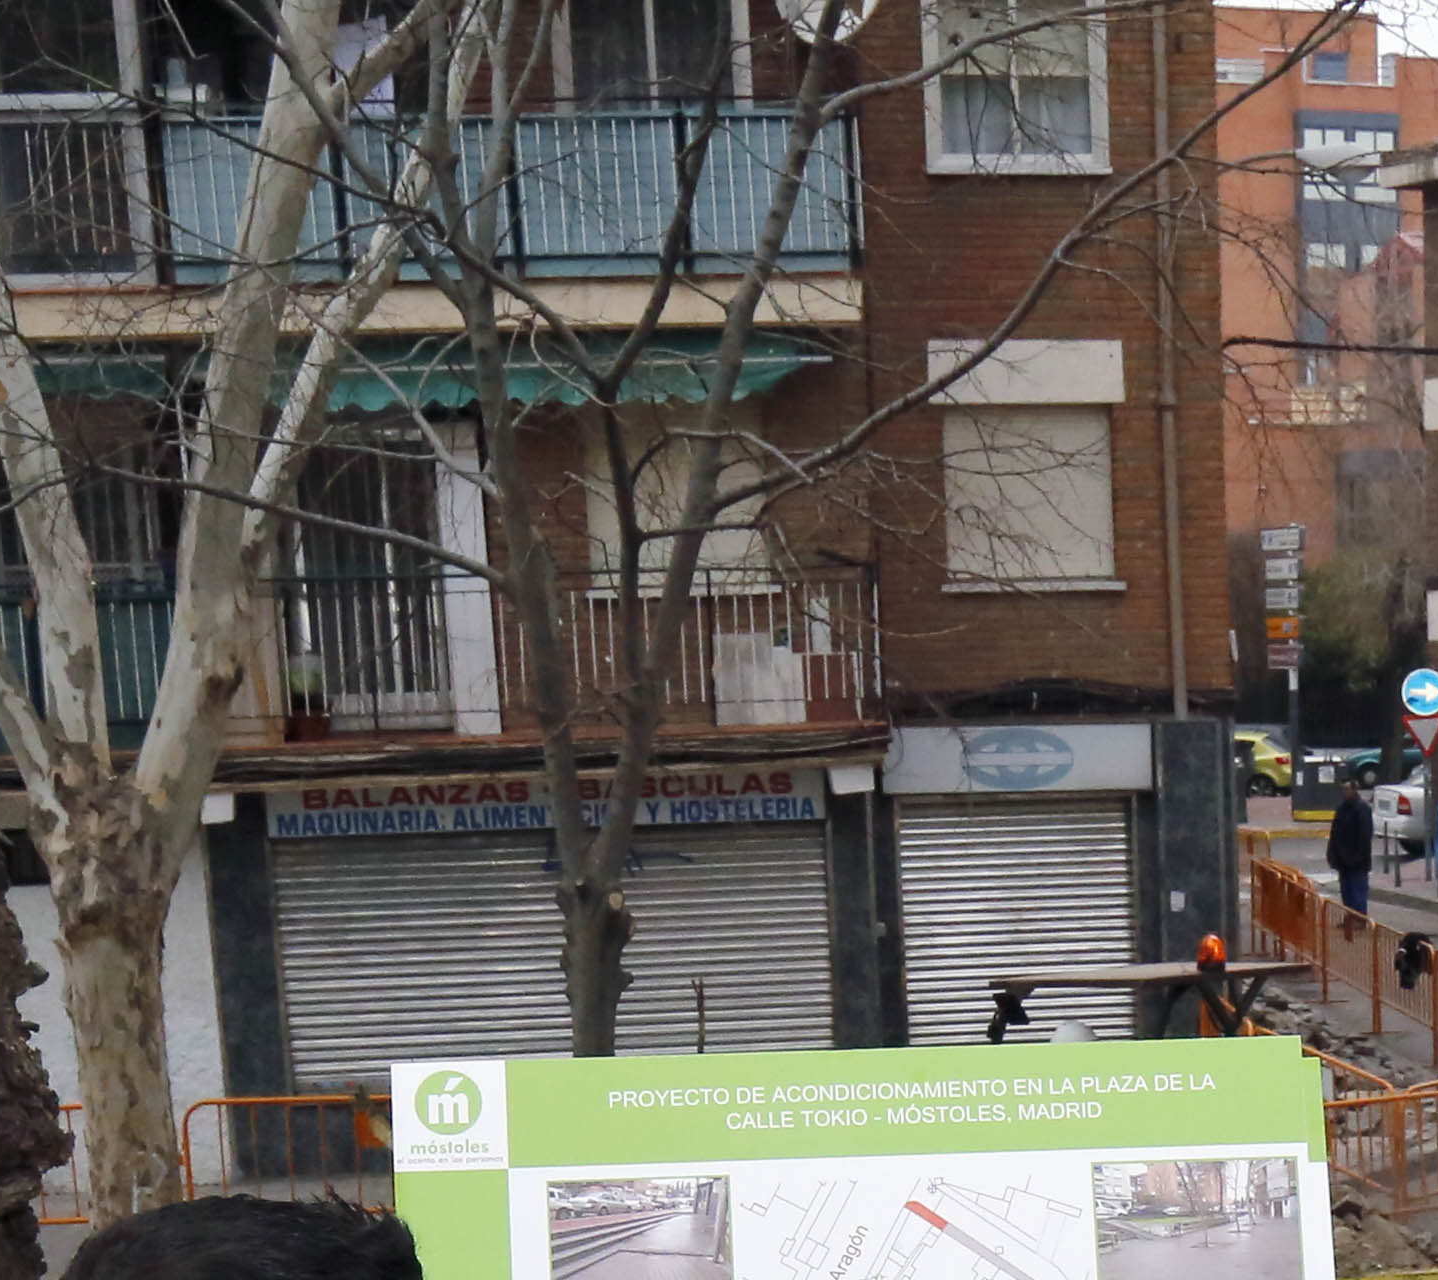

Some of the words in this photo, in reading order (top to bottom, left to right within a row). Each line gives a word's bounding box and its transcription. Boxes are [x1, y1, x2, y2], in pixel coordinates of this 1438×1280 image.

[302, 780, 529, 810] BALANZAS
[646, 801, 660, 823] Y
[669, 796, 816, 823] HOSTELERIA
[609, 1085, 730, 1109] PROYECTO
[736, 1084, 766, 1106] DE
[771, 1077, 1008, 1104] ACONDICIONAMIENTO
[1012, 1076, 1043, 1096] EN
[1048, 1075, 1077, 1095] LA
[1080, 1074, 1150, 1094] PLAZA
[1155, 1073, 1185, 1092] DE
[1190, 1071, 1216, 1091] LA
[725, 1109, 795, 1131] CALLE
[799, 1106, 868, 1129] TOKIO
[887, 1101, 1012, 1125] MÓSTOLES,
[1019, 1100, 1103, 1123] MADRID
[410, 1138, 490, 1155] móstoles
